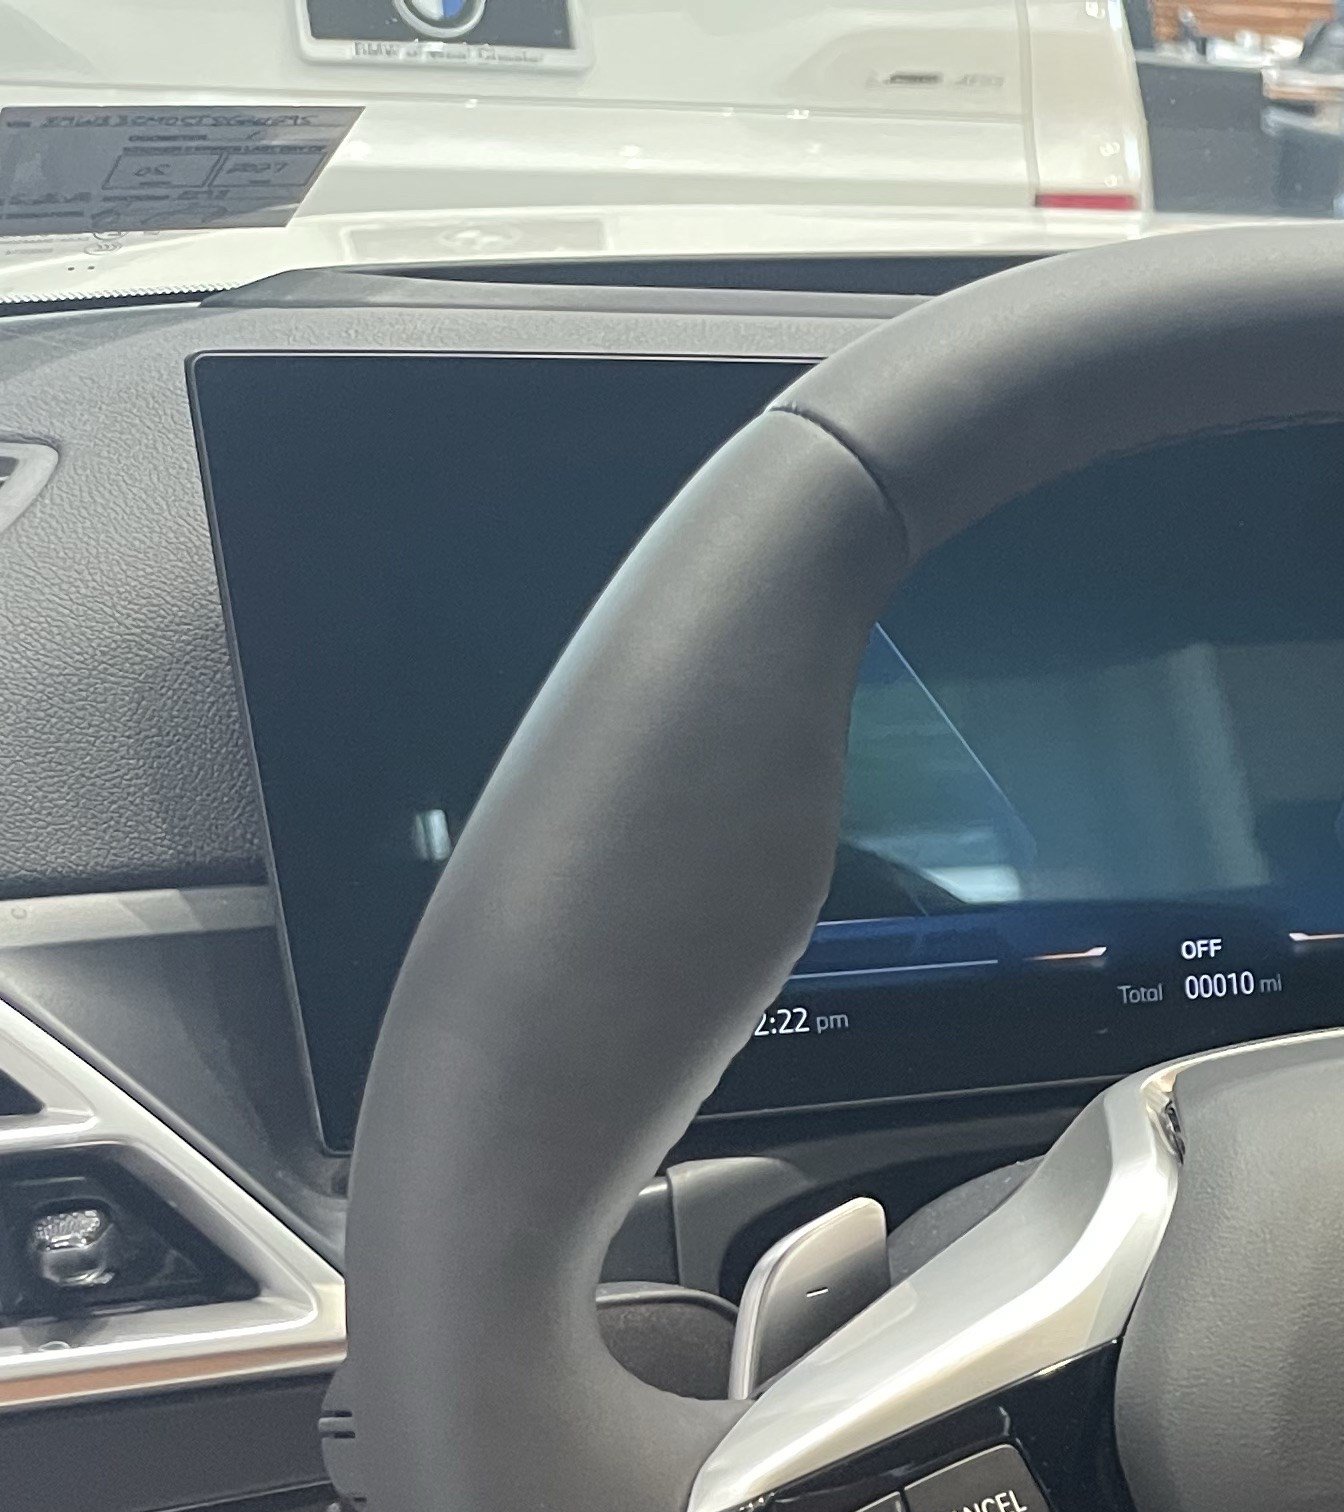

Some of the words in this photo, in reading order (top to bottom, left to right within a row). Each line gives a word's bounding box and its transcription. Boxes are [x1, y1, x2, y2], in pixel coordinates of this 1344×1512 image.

[1181, 939, 1222, 960] OFF
[1117, 983, 1163, 1004] Total
[1185, 971, 1255, 1000] 00010
[1260, 974, 1282, 993] mi
[816, 1014, 849, 1034] pm
